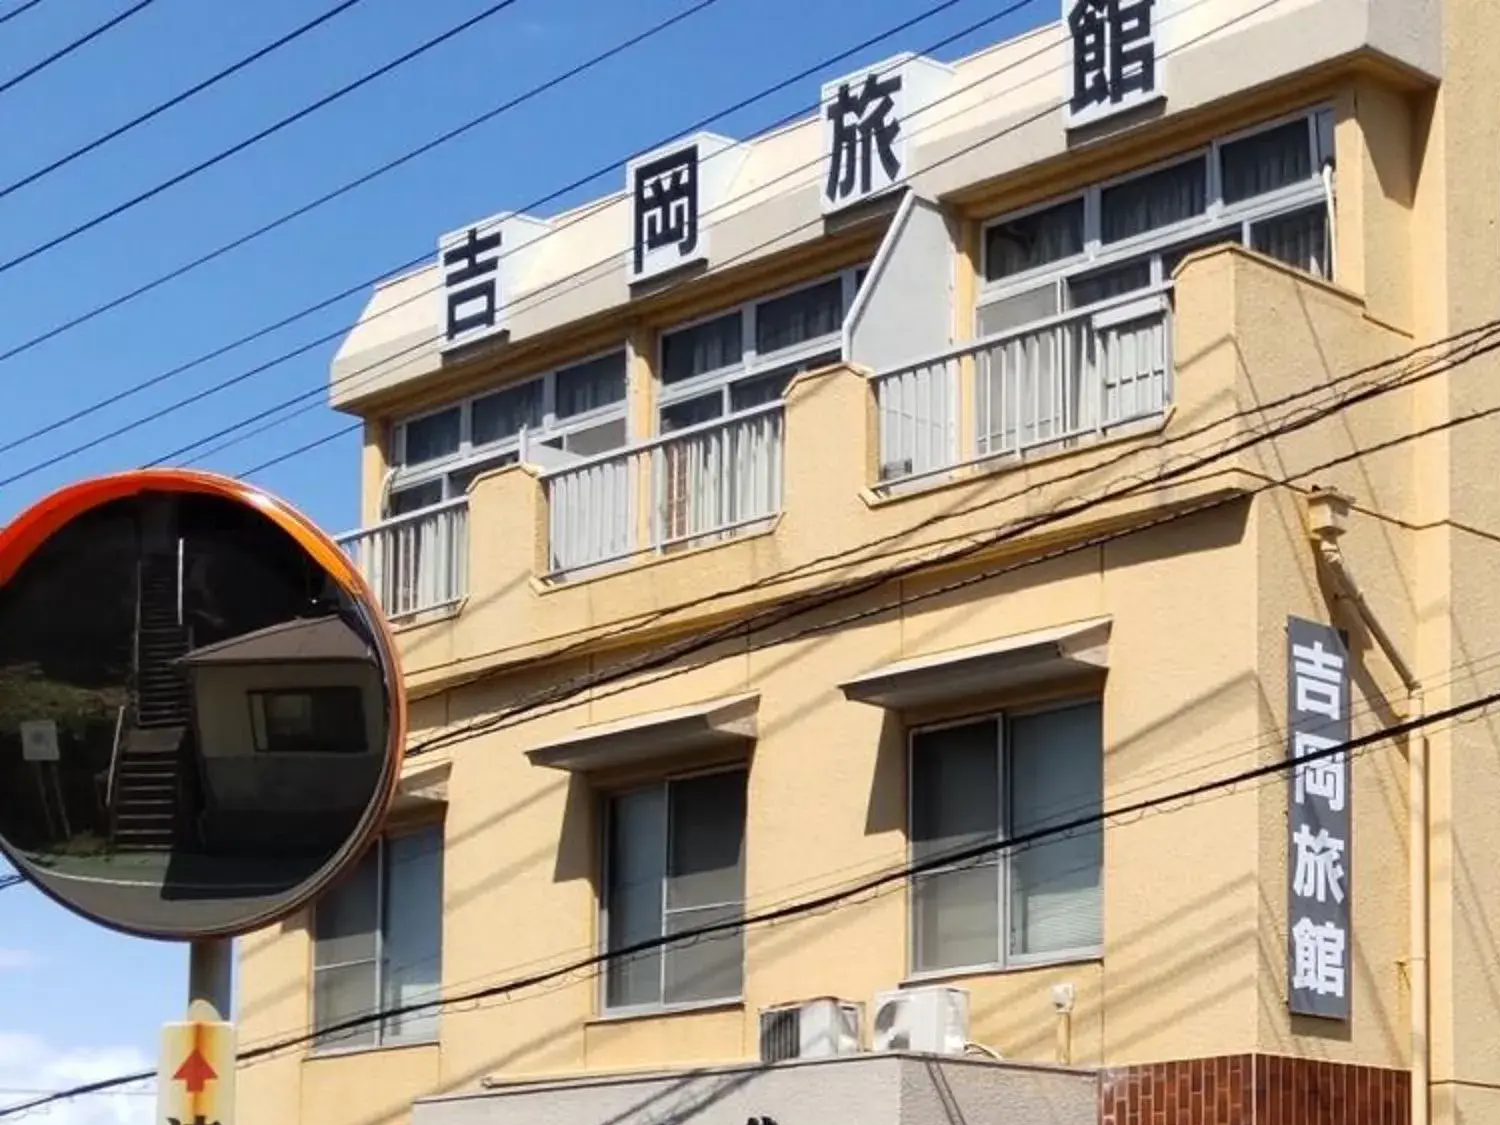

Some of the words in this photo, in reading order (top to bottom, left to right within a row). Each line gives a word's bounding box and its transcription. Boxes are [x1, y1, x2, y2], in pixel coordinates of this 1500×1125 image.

[444, 0, 1154, 341] 吉岡旅館
[1292, 641, 1345, 998] 吉岡旅館
